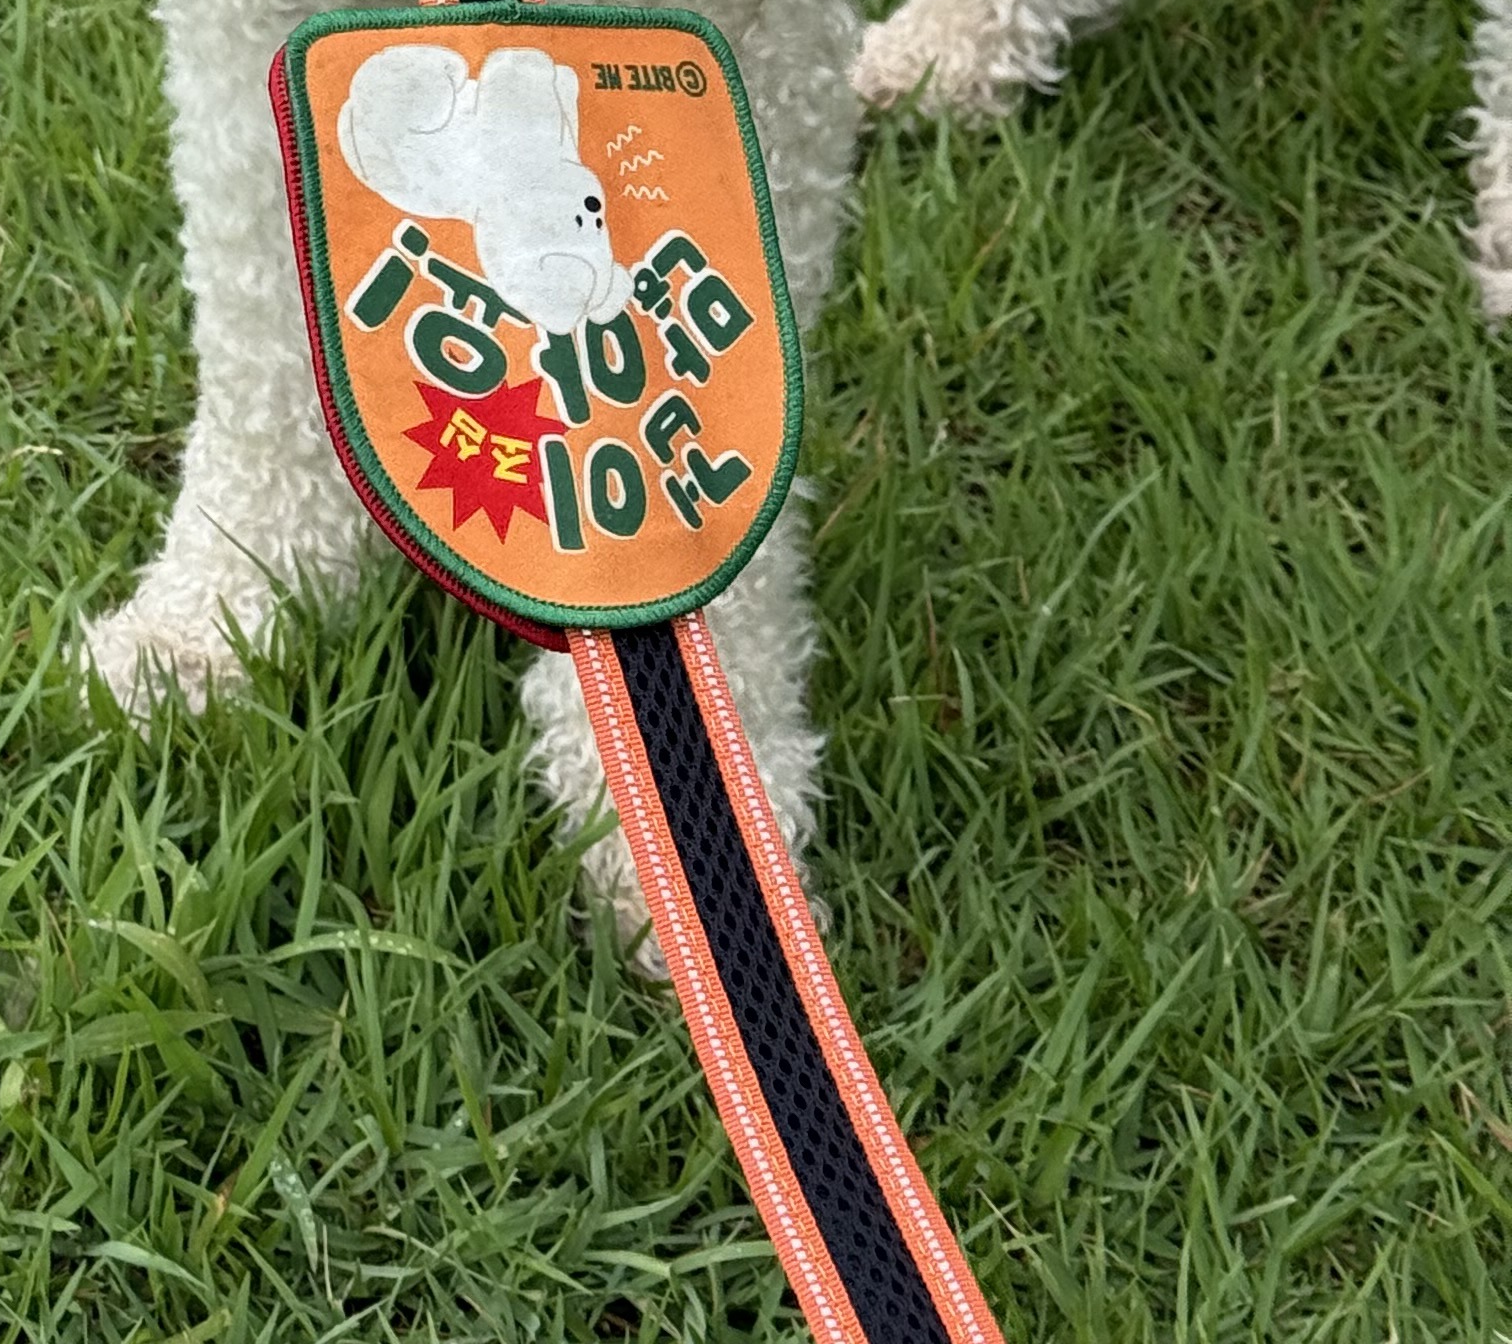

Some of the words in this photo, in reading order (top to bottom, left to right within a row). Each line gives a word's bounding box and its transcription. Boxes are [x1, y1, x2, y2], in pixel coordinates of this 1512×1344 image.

[591, 63, 622, 90] ME
[346, 221, 755, 428] 많아요!
[439, 408, 533, 483] 조심
[540, 389, 753, 552] 겁이
